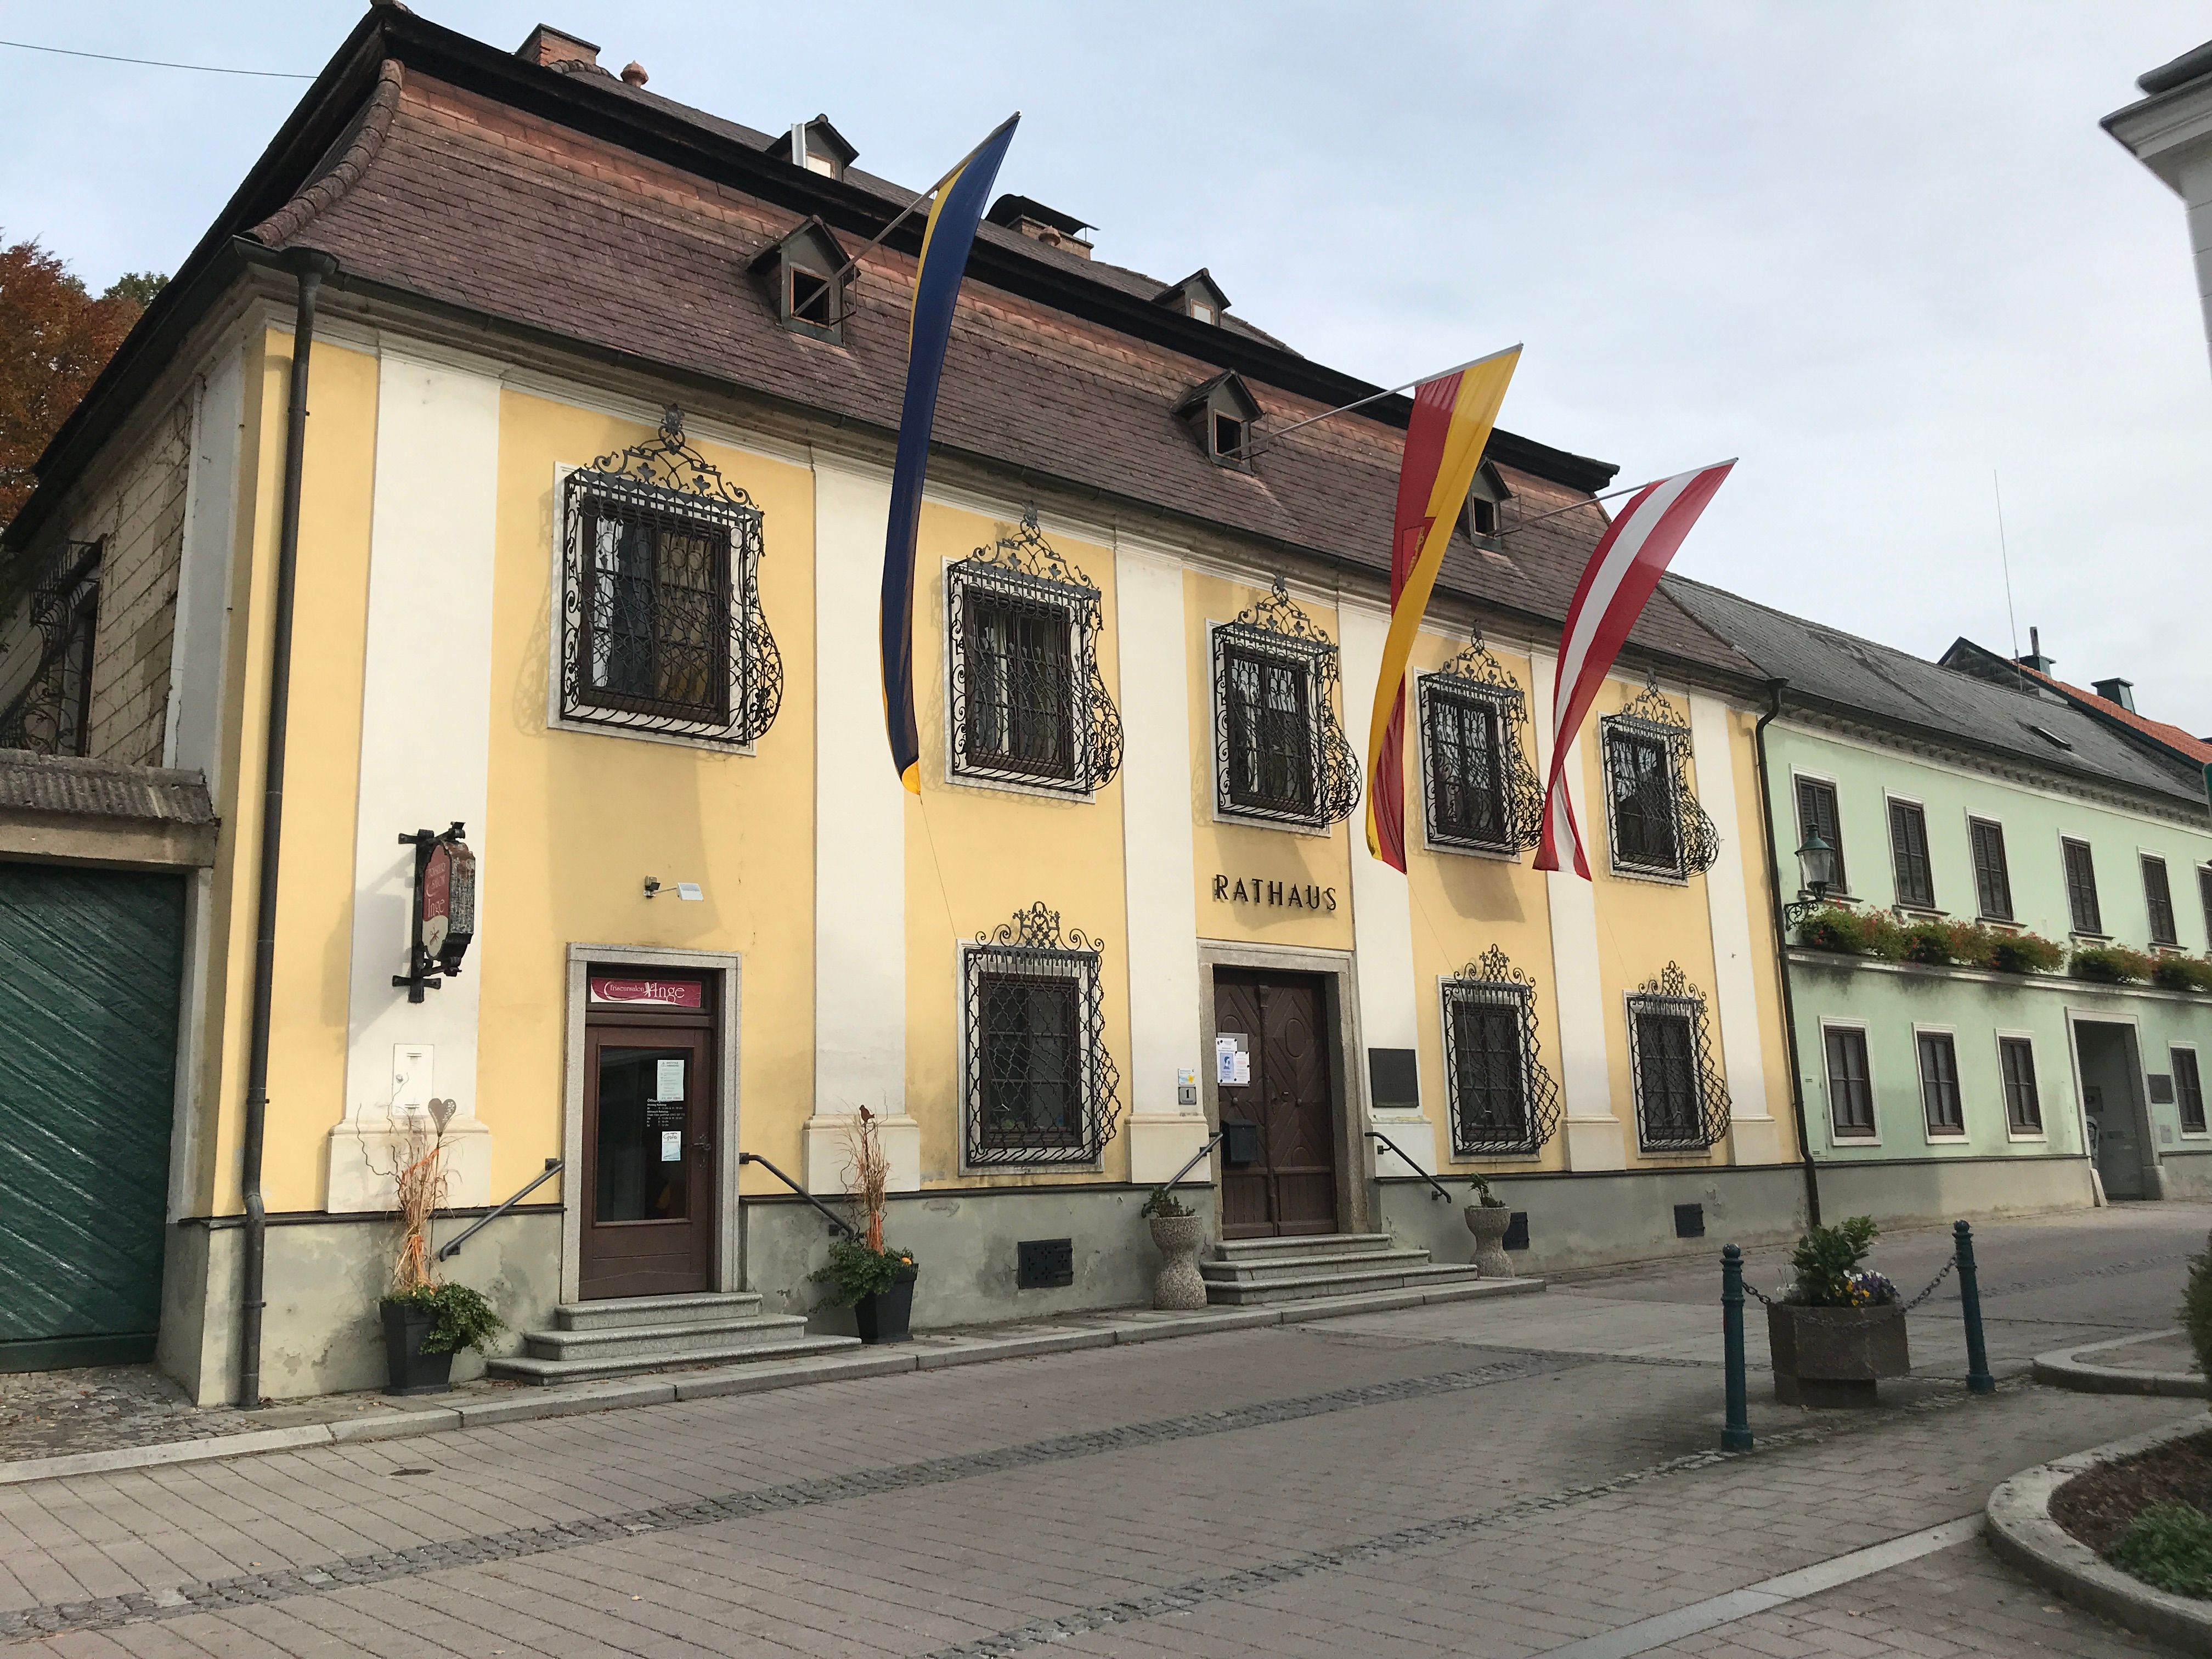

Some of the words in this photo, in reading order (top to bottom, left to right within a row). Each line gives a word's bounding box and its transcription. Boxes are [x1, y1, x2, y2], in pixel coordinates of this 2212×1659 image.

[1215, 874, 1336, 911] RATHAUS
[427, 898, 445, 918] Inge
[653, 982, 685, 1003] Inge
[1186, 1089, 1190, 1098] 1
